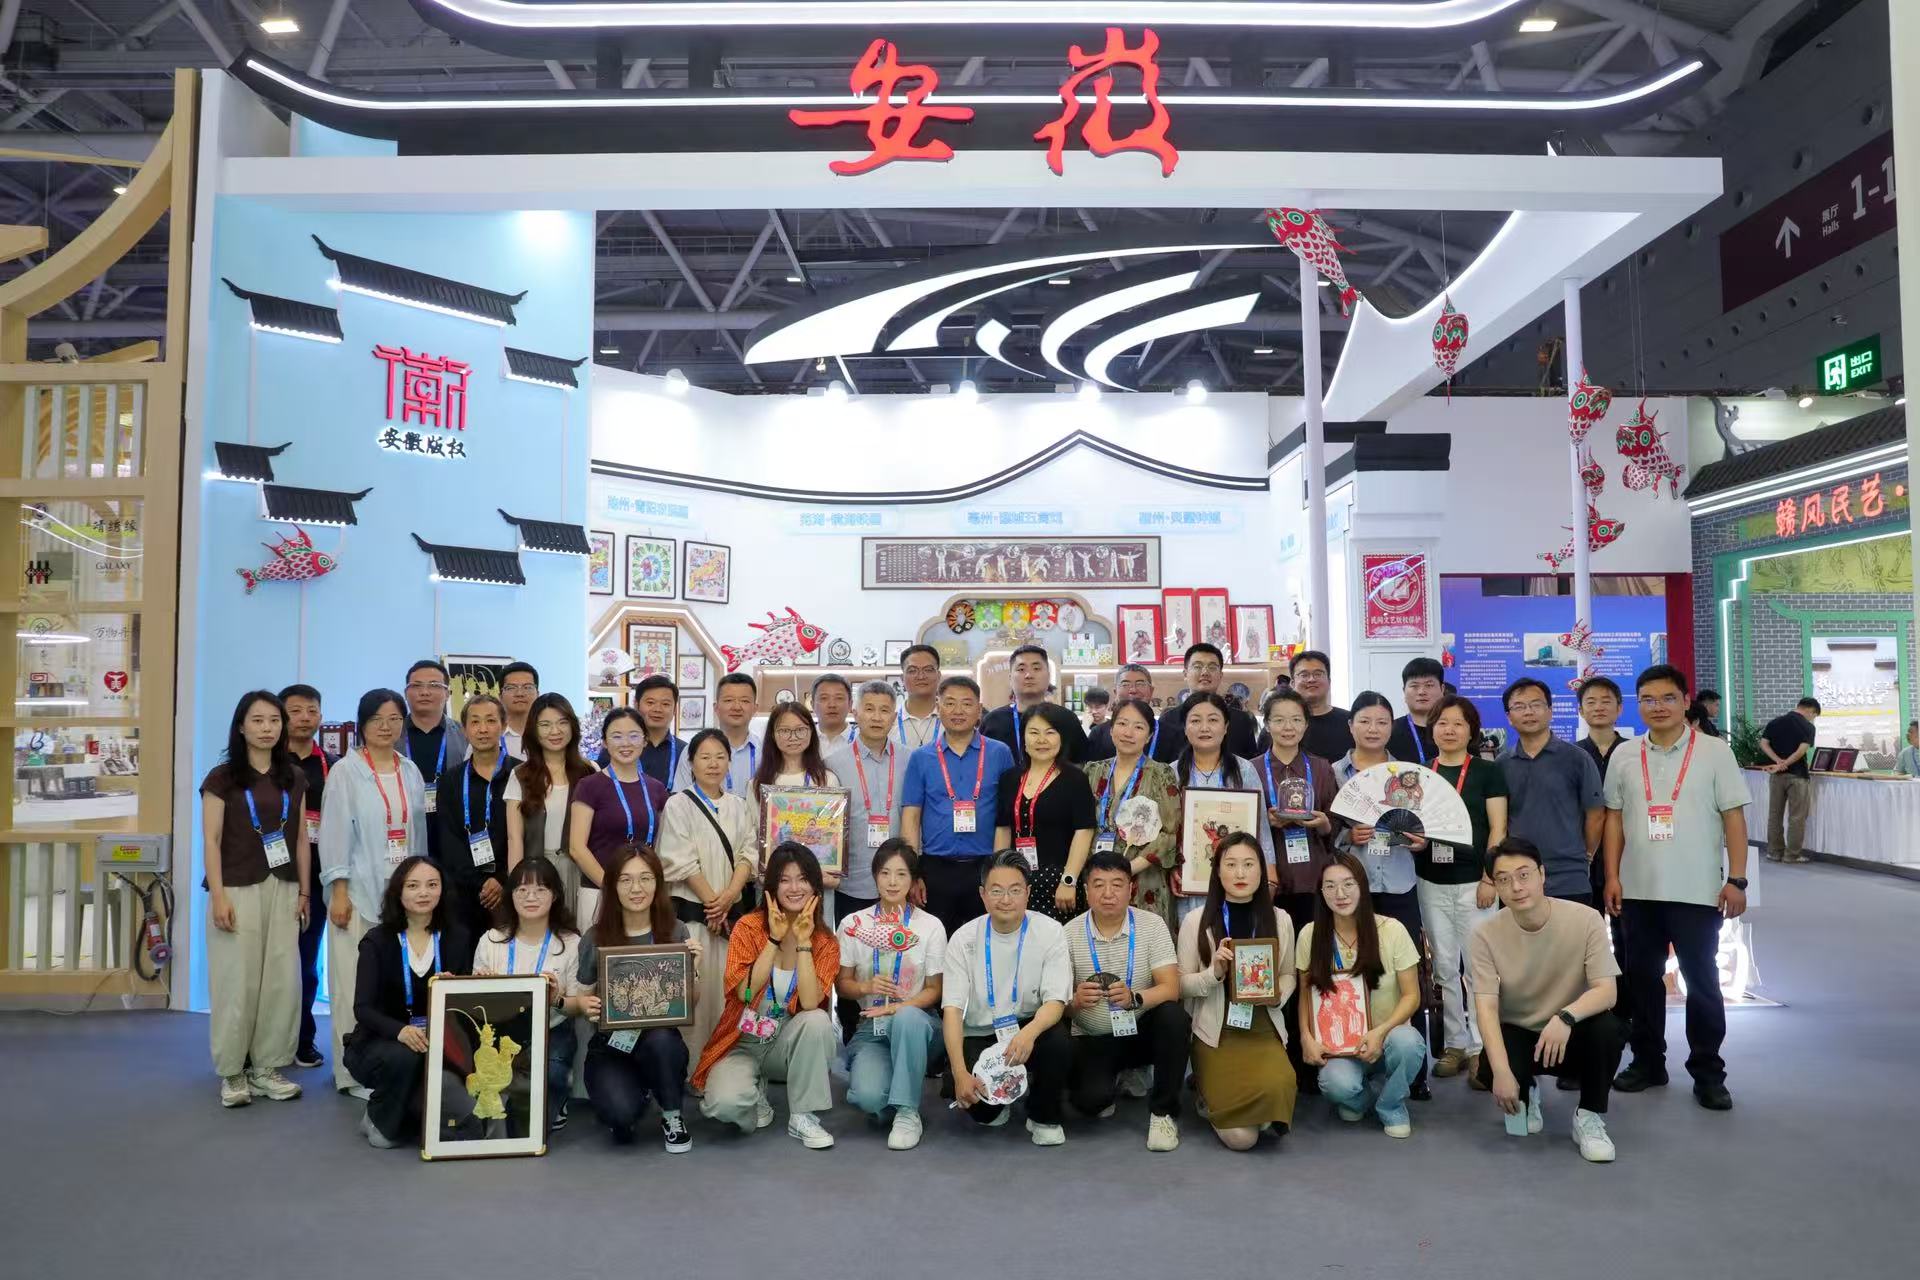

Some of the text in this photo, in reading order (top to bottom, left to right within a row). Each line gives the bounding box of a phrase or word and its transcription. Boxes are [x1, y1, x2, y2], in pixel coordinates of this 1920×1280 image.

[1822, 221, 1840, 237] Halls
[1850, 350, 1872, 367] 出口
[1850, 362, 1873, 378] EXIT
[378, 427, 467, 459] 安徽版权
[95, 561, 133, 570] GALAXY
